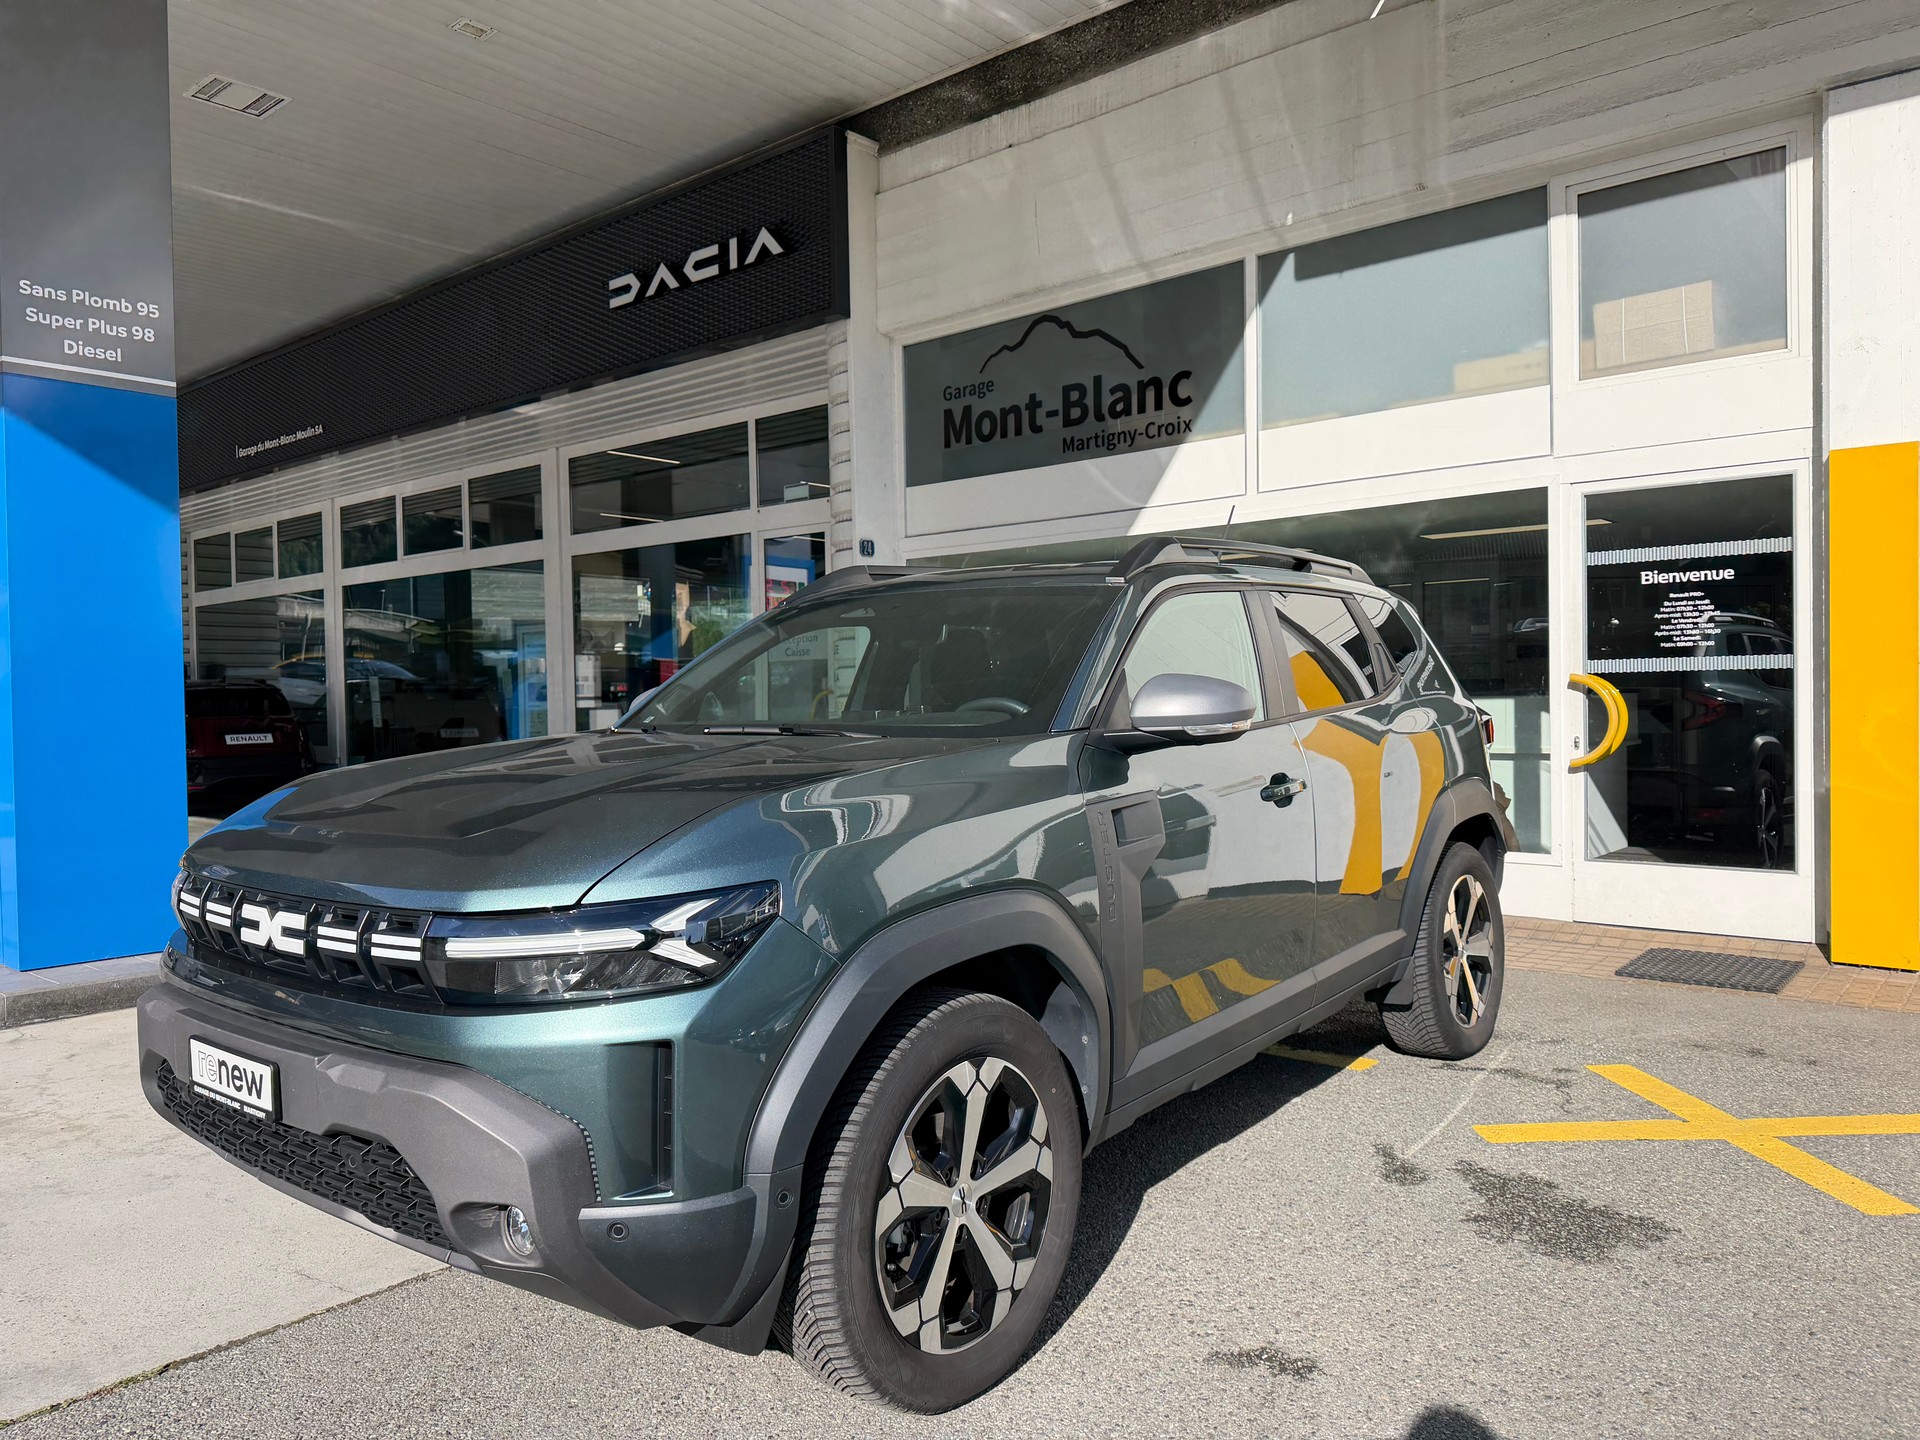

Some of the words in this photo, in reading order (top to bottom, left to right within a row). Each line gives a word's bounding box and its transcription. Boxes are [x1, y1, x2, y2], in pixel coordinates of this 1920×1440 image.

[608, 225, 785, 310] DACIA
[18, 279, 67, 302] Sans
[72, 289, 133, 314] Plomb
[136, 301, 160, 319] 95
[25, 307, 84, 330] Super
[88, 317, 128, 338] Plus
[131, 325, 155, 343] 98
[63, 339, 122, 362] Diesel
[943, 379, 995, 402] Garage
[943, 369, 1193, 449] Mont-Blanc
[238, 445, 257, 458] Garage
[257, 441, 265, 452] du
[264, 434, 296, 450] Mont-Blanc
[296, 426, 315, 441] Moulin
[315, 424, 324, 435] SA
[1061, 416, 1193, 454] Martigny-Croix
[1640, 568, 1735, 585] Bienvenue
[784, 646, 811, 657] Caisse
[230, 735, 268, 743] RENAULT
[197, 1050, 264, 1100] renew
